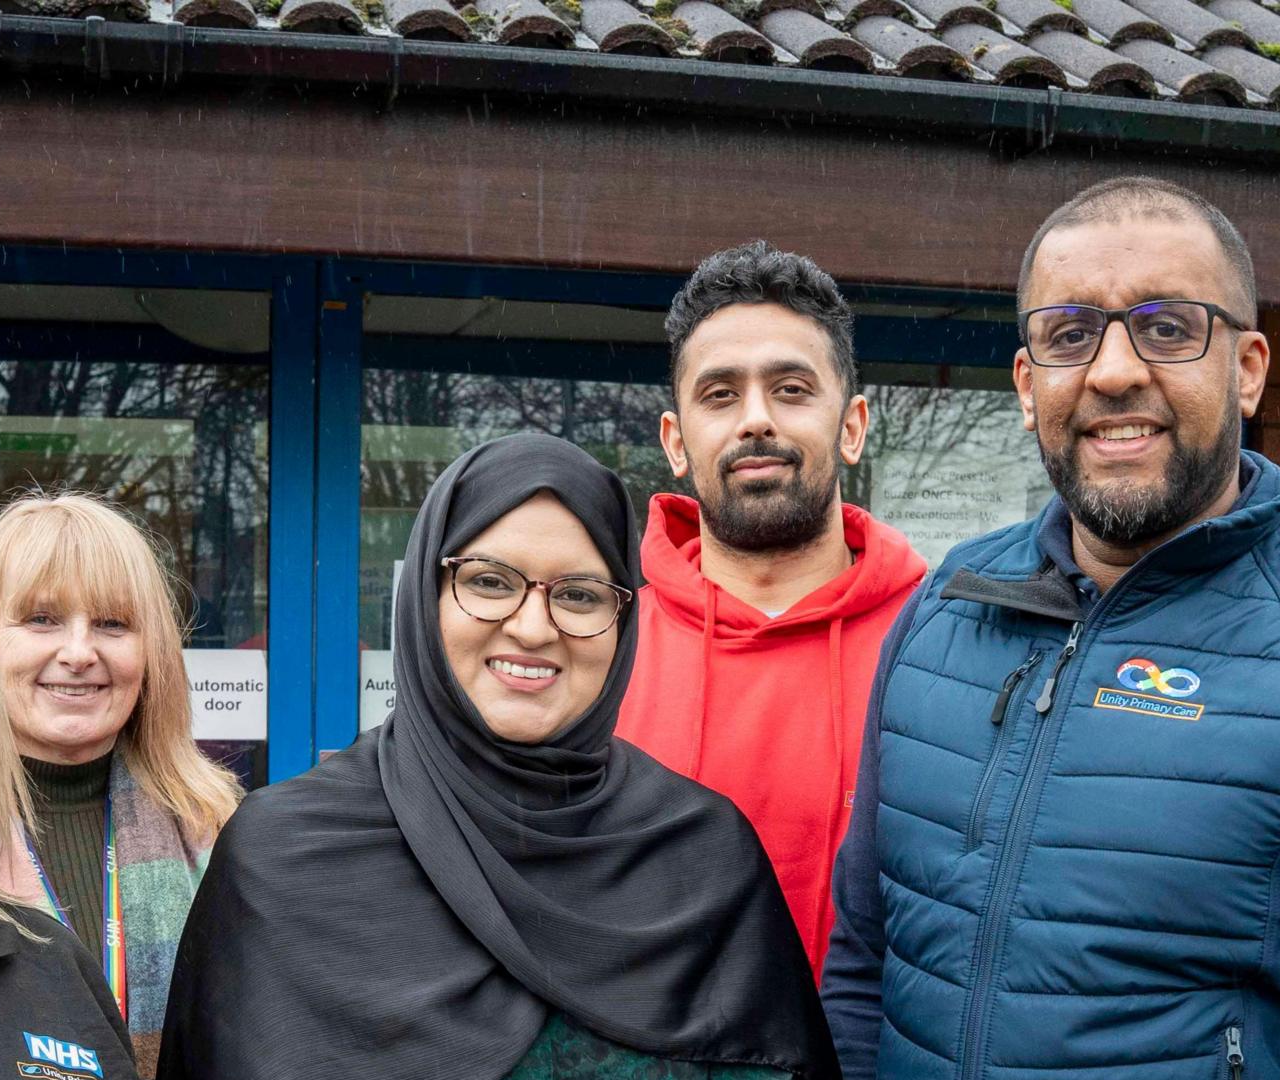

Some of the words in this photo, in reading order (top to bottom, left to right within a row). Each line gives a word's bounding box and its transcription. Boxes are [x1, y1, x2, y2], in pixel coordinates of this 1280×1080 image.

[922, 489, 953, 500] ONCE
[204, 698, 242, 711] door
[1100, 693, 1127, 708] Unity
[1130, 698, 1172, 714] Primary
[1173, 706, 1198, 717] Care
[30, 1036, 98, 1071] NHS
